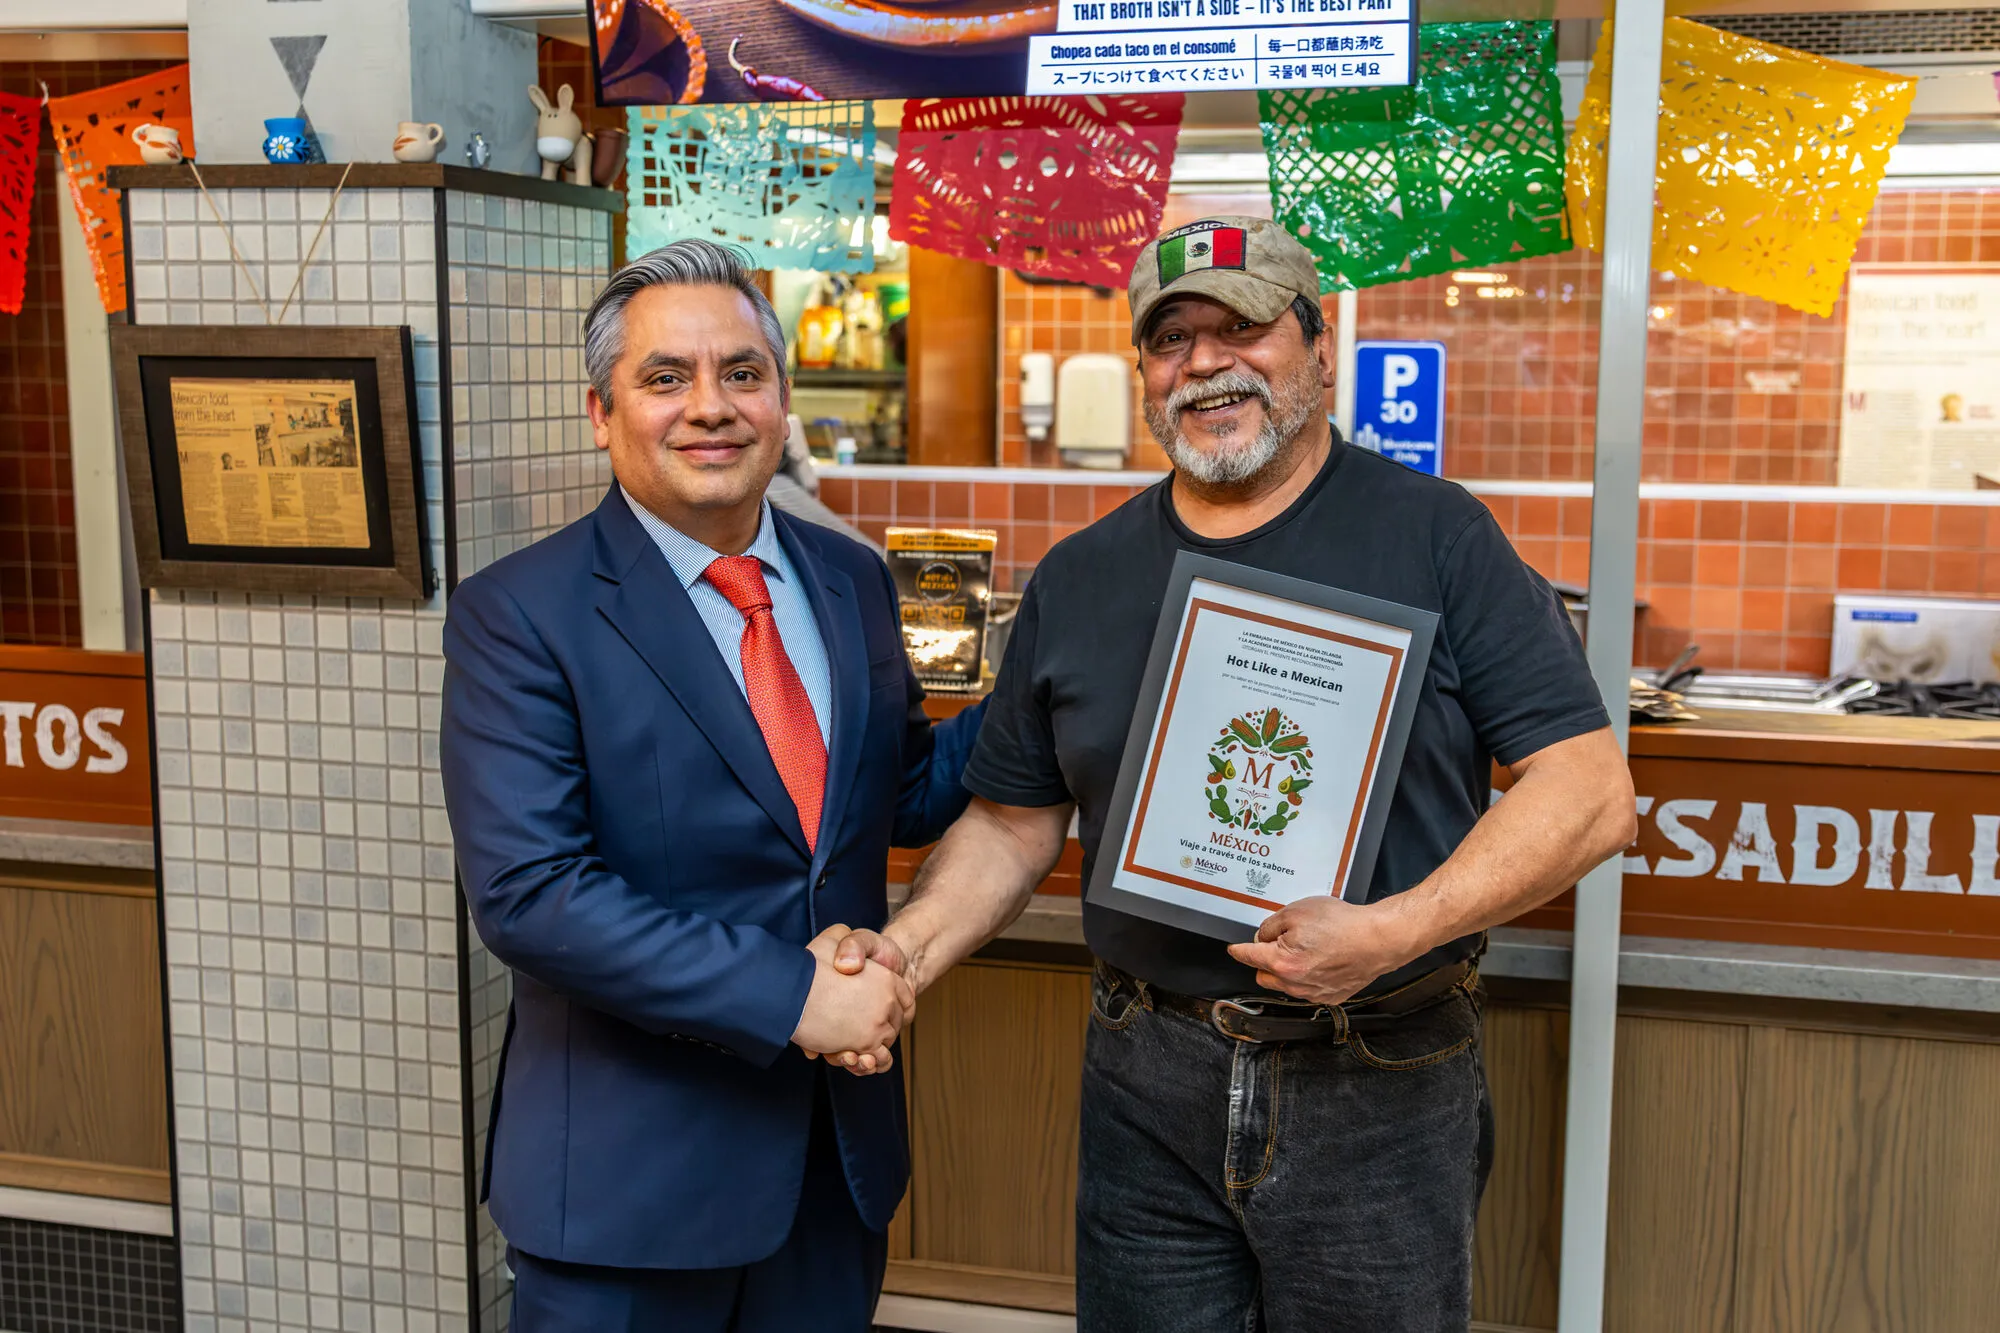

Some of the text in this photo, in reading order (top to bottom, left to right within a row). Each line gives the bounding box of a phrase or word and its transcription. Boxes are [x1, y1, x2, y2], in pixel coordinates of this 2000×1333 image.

[1074, 4, 1105, 21] THAT
[1110, 2, 1153, 20] BROTH
[1158, 0, 1192, 18] ISN'T
[1197, 0, 1206, 16] A
[1210, 0, 1240, 16] SIDE
[1260, 0, 1285, 14] IT'S
[1291, 0, 1315, 13] THE
[1320, 0, 1352, 12] BEST
[1051, 38, 1236, 60] Chopea cada taco en el consomé
[1053, 67, 1245, 86] スープにつけて食べてください
[1268, 62, 1381, 80] 국물에 찍어 드세요
[1383, 354, 1419, 399] P
[173, 391, 229, 406] Mexican food
[174, 408, 236, 424] from the heart
[1380, 400, 1418, 424] 30
[1226, 654, 1343, 692] Hot Like a Mexican
[0, 701, 128, 774] TOS
[1241, 757, 1275, 789] M
[1210, 831, 1270, 857] MÉXICO
[1180, 839, 1200, 852] Viaje
[1209, 846, 1235, 859] través
[1236, 853, 1247, 862] de
[1249, 857, 1262, 866] los
[1262, 860, 1295, 875] sabores
[1195, 857, 1228, 873] México
